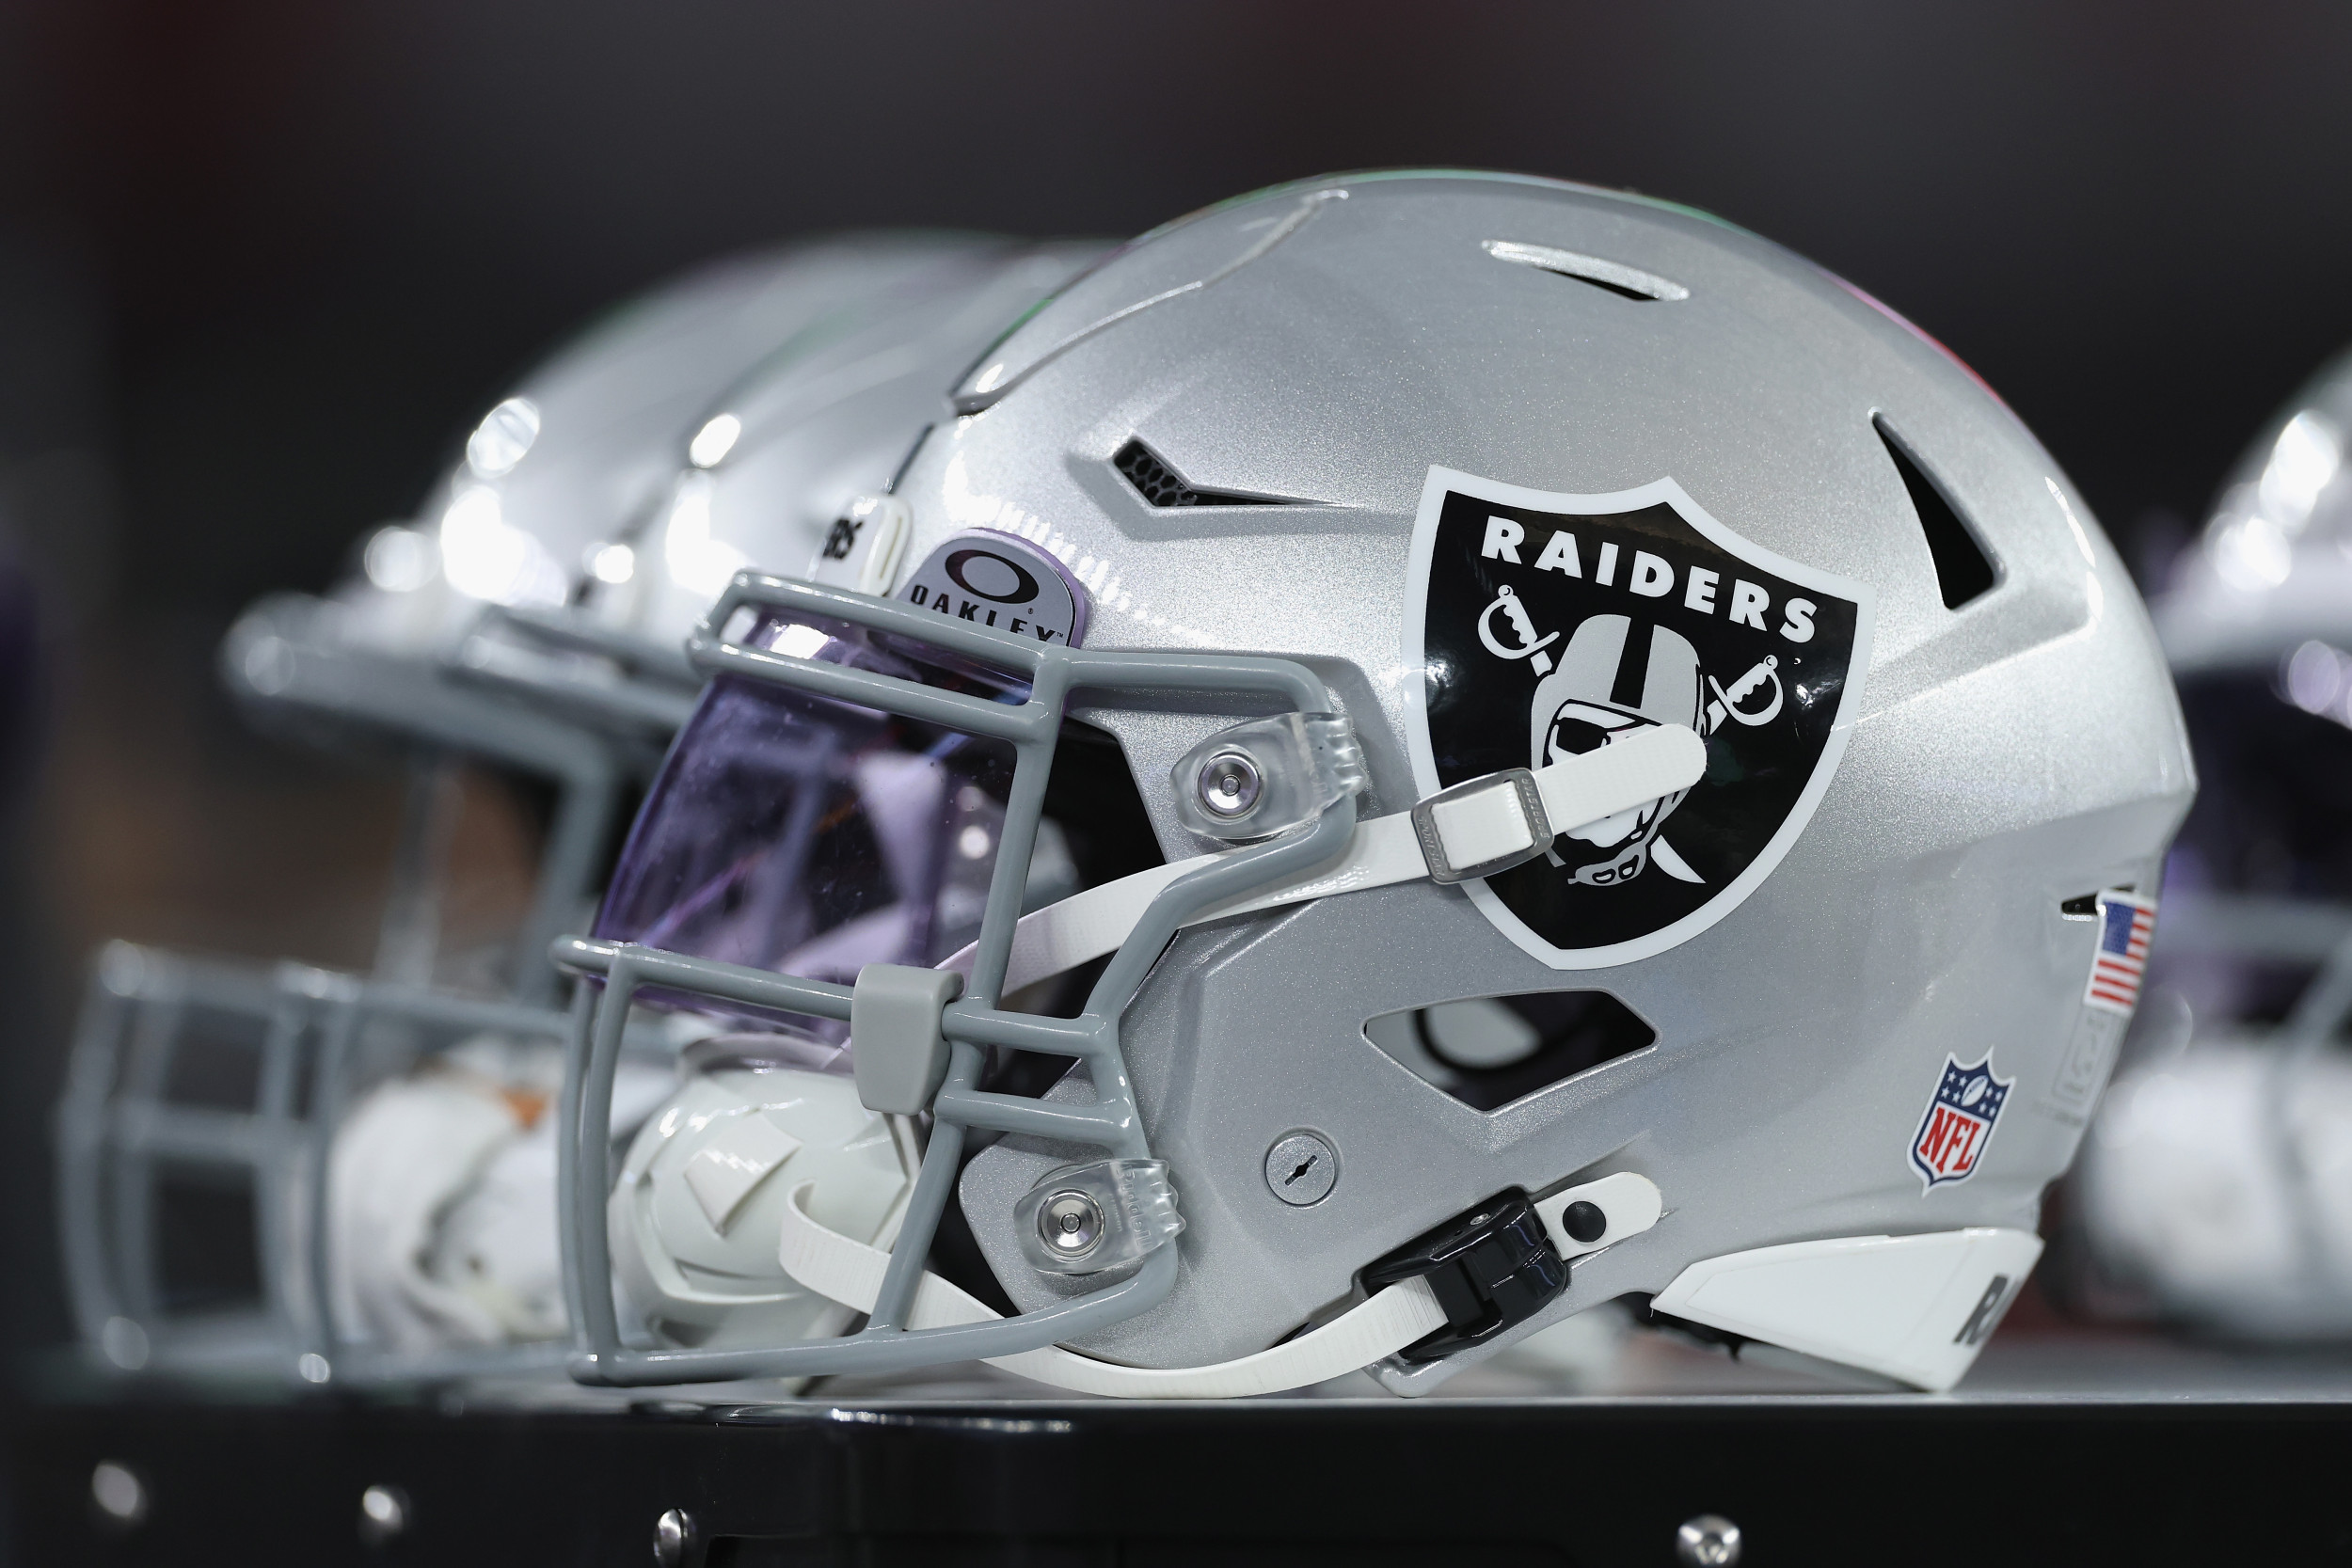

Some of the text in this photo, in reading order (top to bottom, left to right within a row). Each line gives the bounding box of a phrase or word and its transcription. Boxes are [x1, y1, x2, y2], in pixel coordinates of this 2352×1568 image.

[1481, 515, 1818, 642] RAIDERS
[1521, 777, 1550, 839] SPORTSTAR
[1919, 1106, 1980, 1174] NFL
